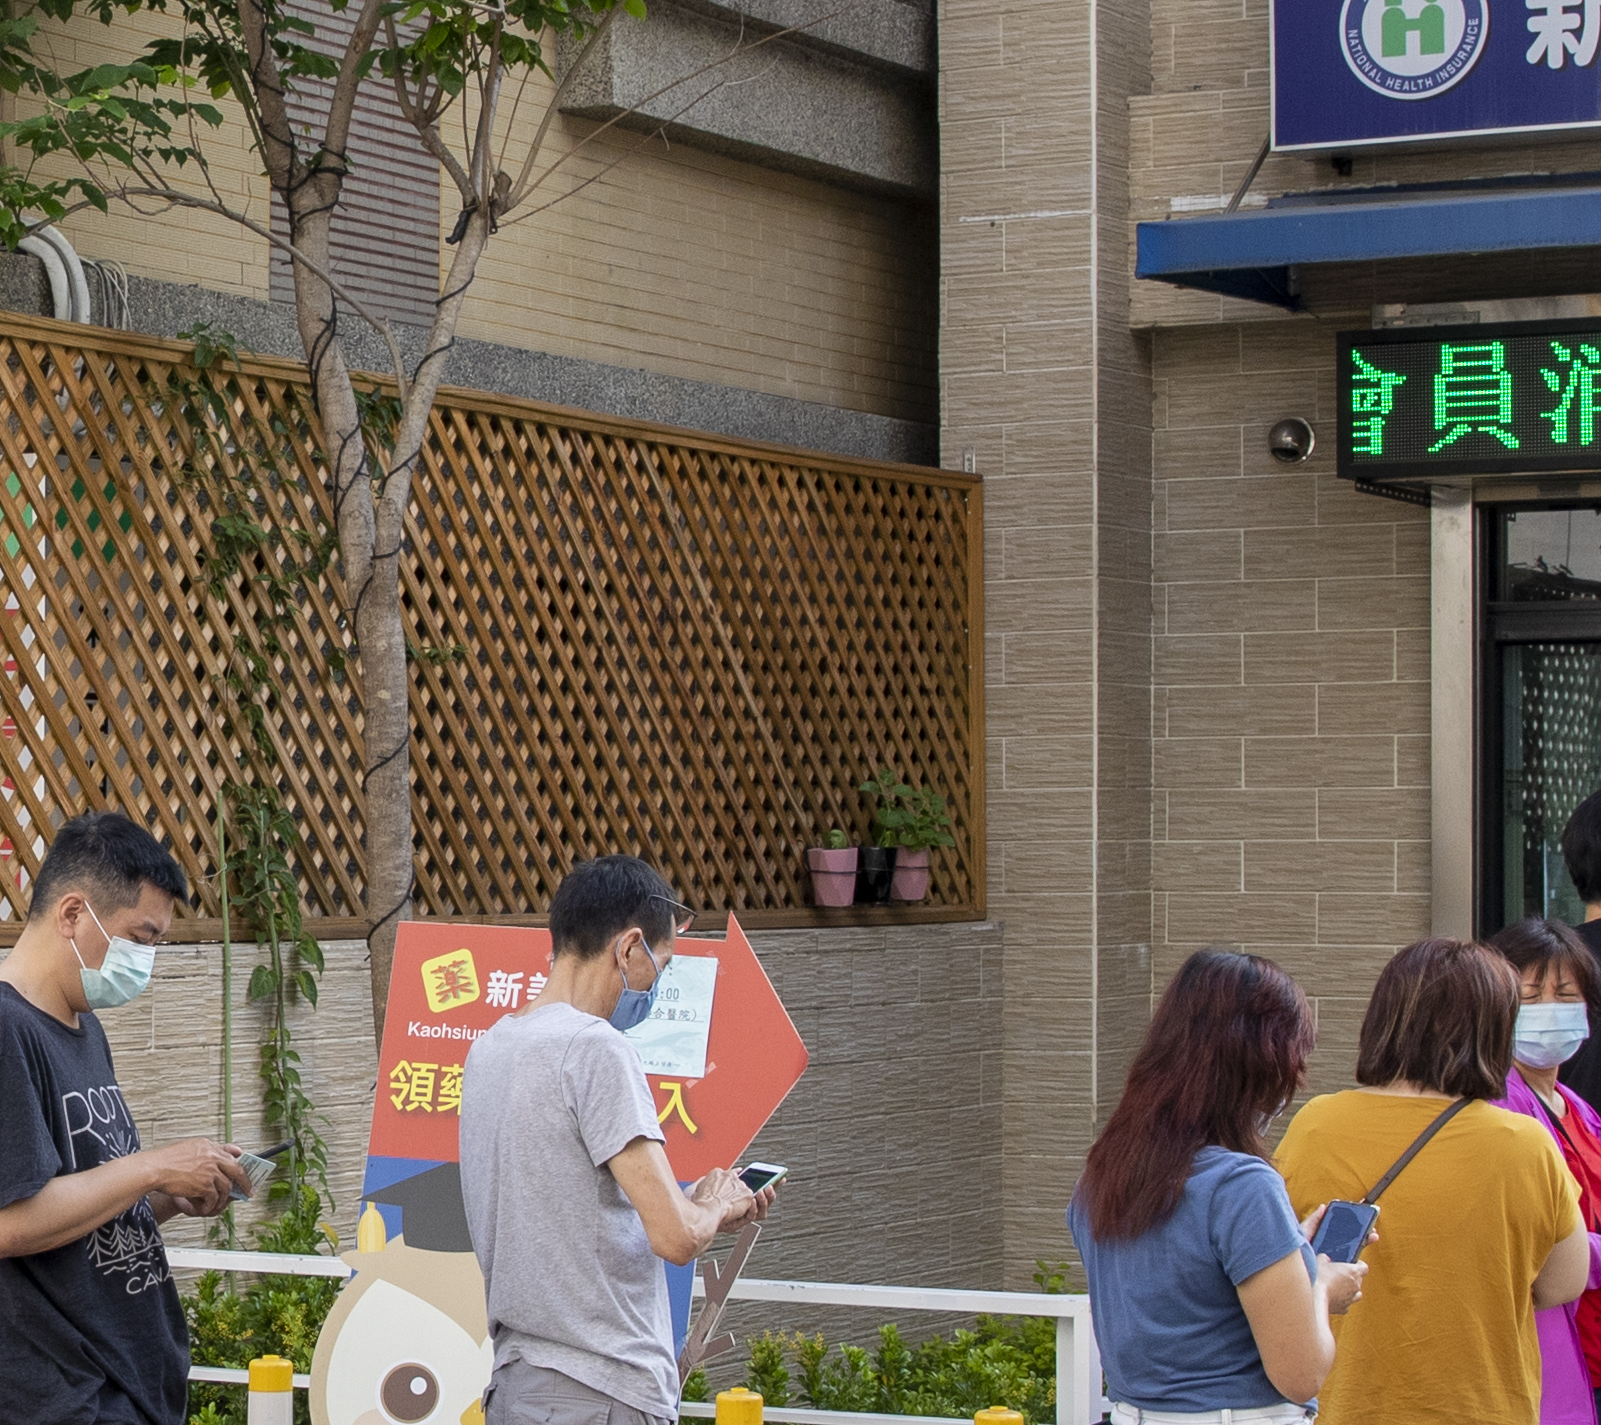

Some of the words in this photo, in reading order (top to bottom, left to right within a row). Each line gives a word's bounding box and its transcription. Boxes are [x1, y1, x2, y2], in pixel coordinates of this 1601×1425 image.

[1348, 29, 1381, 83] NATIONAL
[1385, 76, 1433, 91] HEALTH
[1436, 18, 1479, 83] INSURANCE
